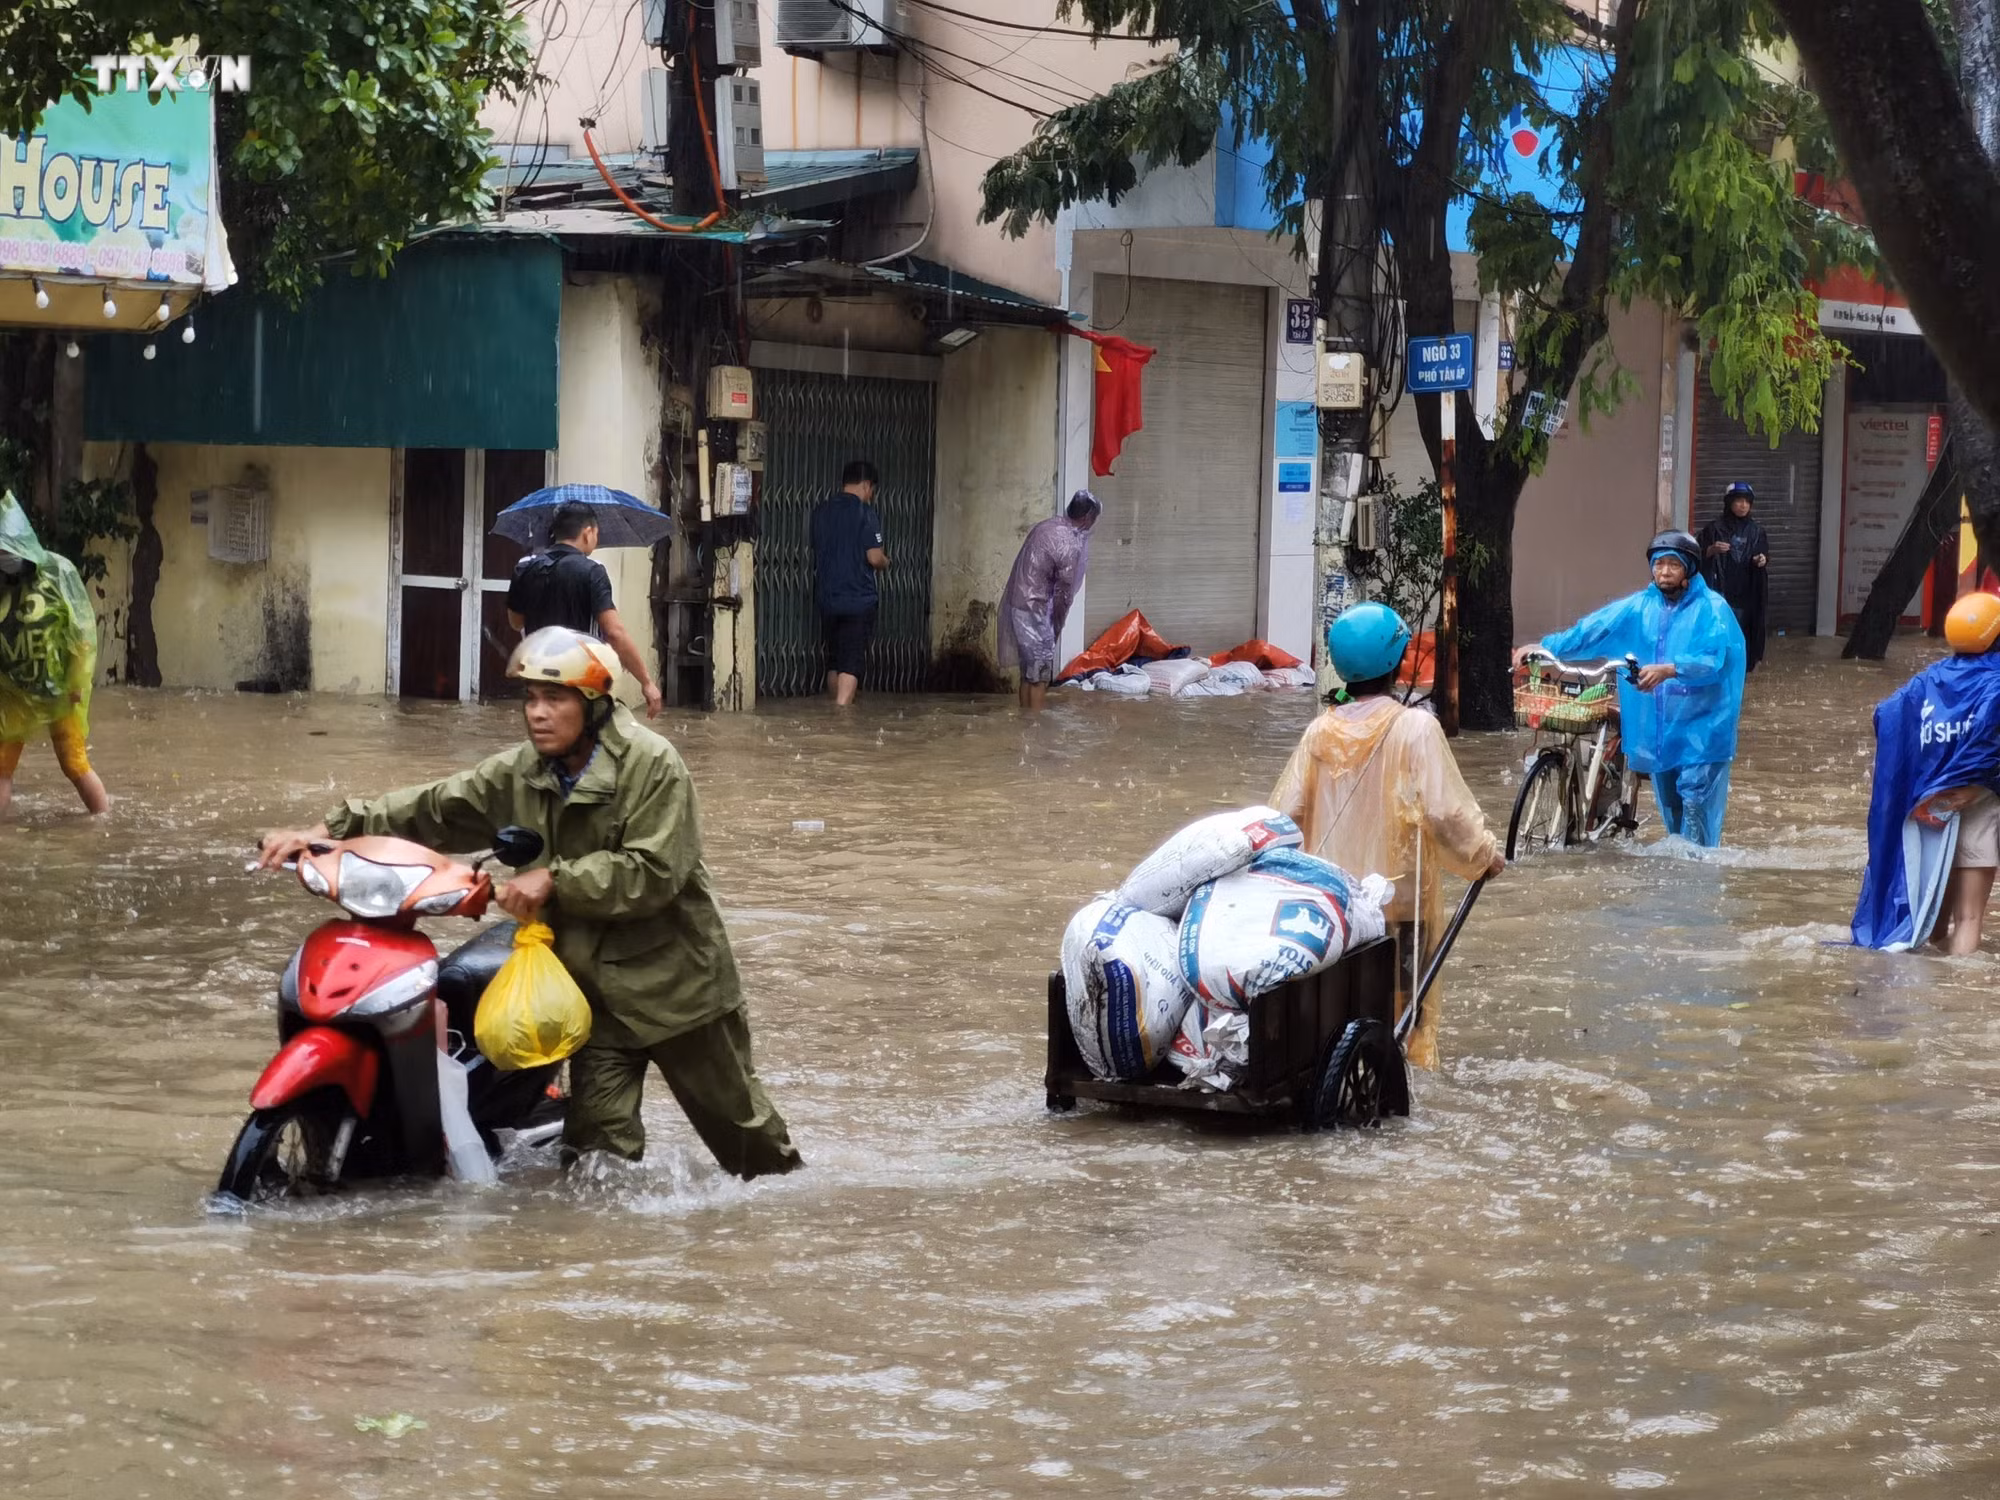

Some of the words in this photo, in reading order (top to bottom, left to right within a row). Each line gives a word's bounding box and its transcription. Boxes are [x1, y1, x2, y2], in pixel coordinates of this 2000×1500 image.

[1290, 303, 1311, 329] 35
[1449, 343, 1461, 360] 33
[1418, 365, 1438, 383] PHỐ
[1439, 366, 1455, 382] TÂN
[1456, 363, 1465, 380] ẤP
[1860, 418, 1909, 431] viettel
